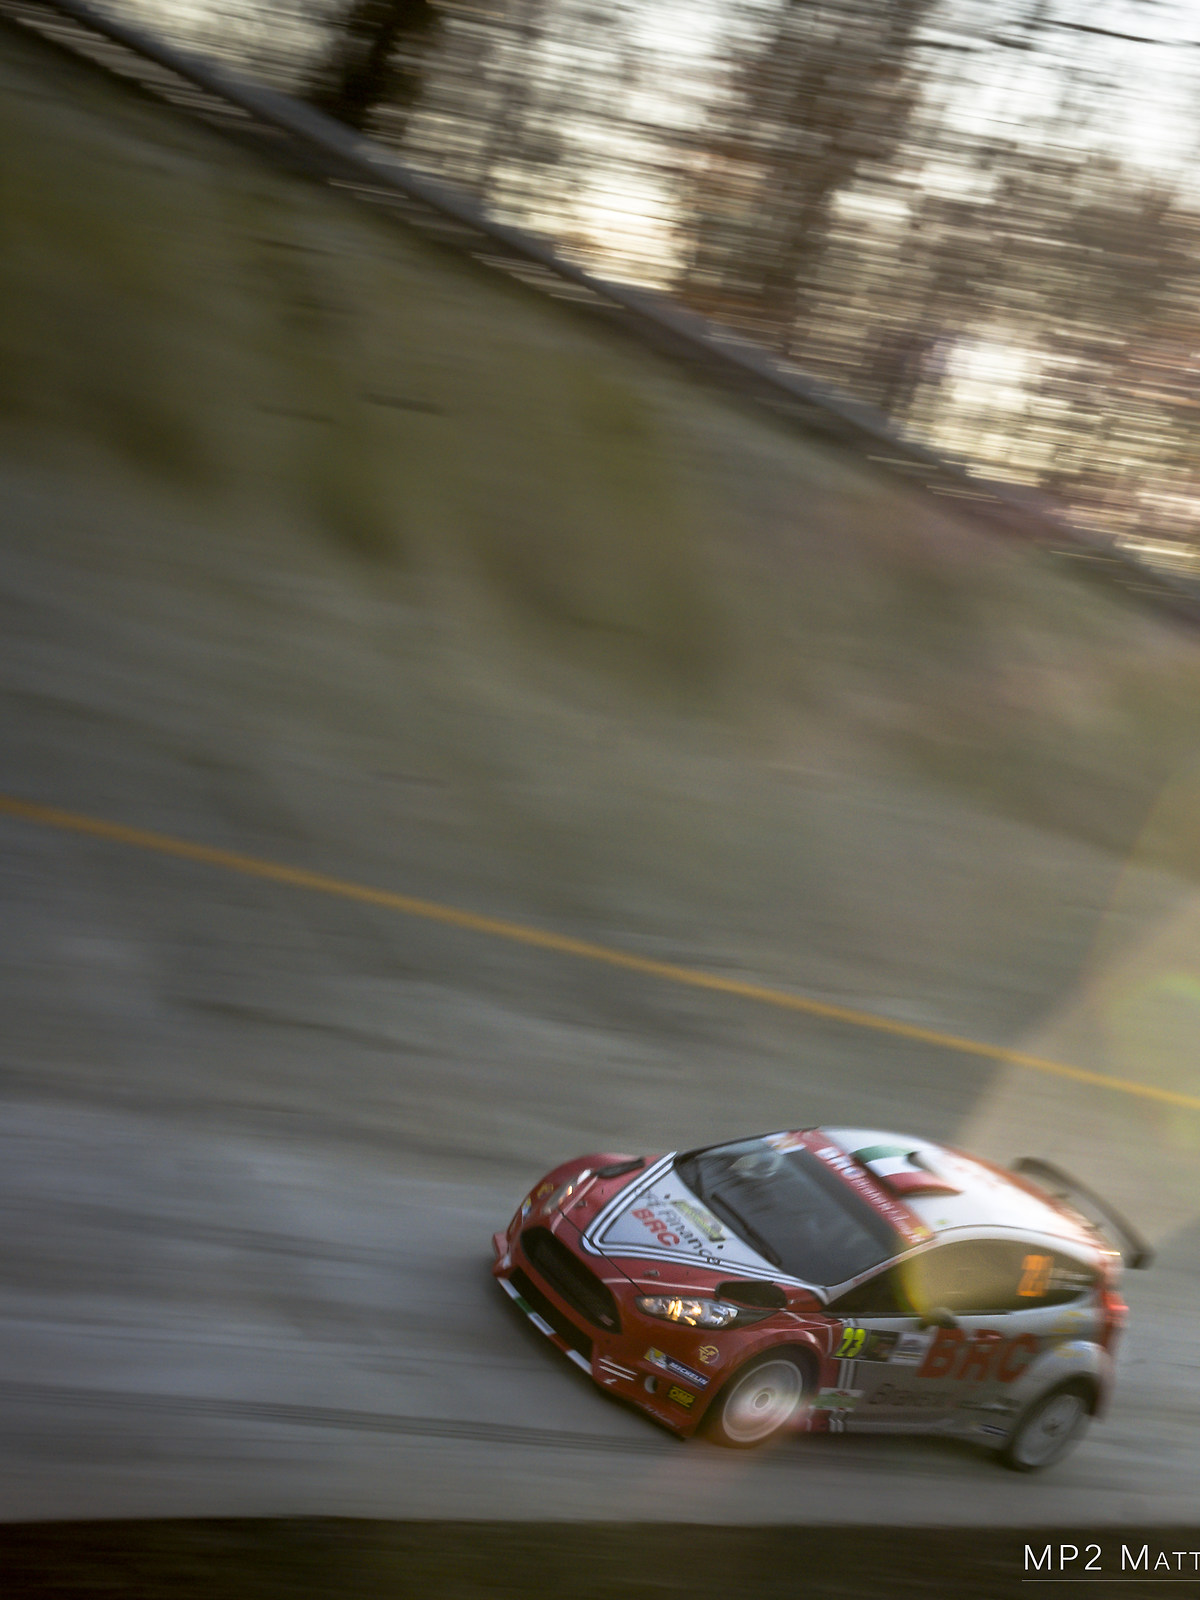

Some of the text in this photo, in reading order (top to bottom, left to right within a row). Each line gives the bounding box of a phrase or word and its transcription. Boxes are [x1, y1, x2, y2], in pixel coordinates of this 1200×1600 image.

[631, 1208, 680, 1246] BRC
[917, 1325, 1038, 1383] BRC
[668, 1362, 709, 1386] MICHELIN
